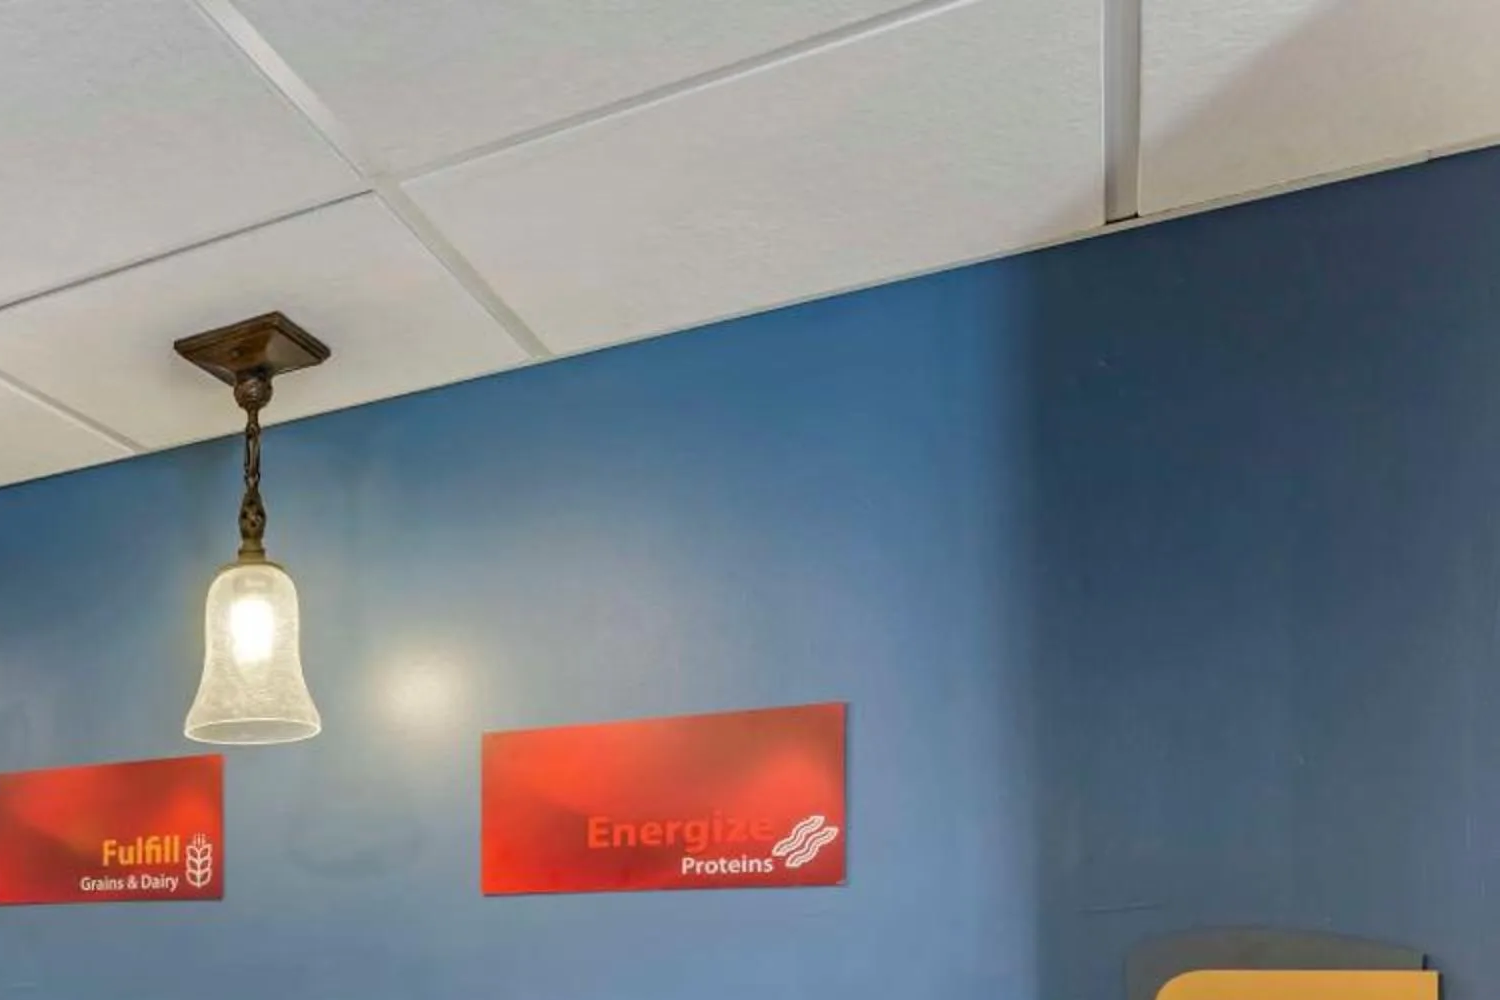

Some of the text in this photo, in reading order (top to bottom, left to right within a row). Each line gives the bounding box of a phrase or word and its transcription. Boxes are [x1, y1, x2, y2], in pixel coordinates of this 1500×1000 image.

[588, 811, 776, 852] Energize
[102, 834, 181, 867] Fulfill
[681, 855, 774, 876] Proteins
[80, 872, 179, 893] Grains & Dairy
